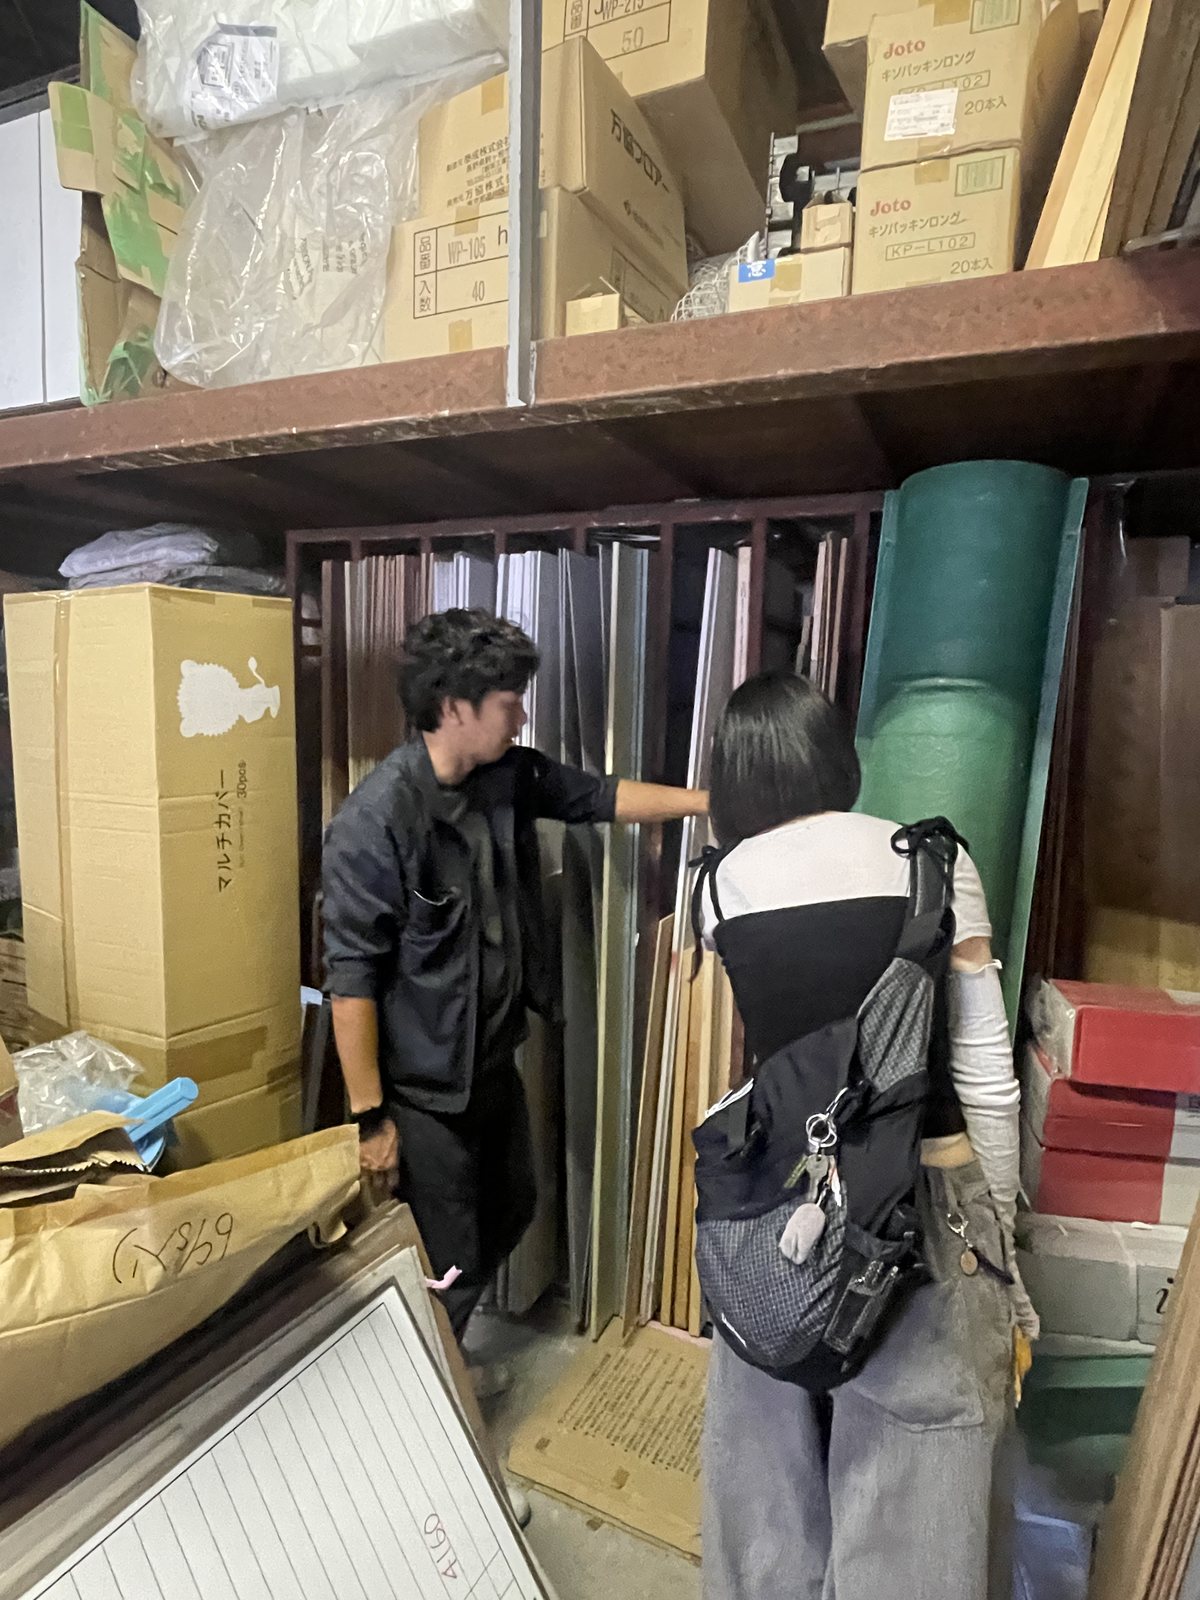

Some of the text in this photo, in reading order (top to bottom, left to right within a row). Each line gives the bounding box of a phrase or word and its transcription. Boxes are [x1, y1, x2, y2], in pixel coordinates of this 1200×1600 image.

[621, 26, 645, 53] 50
[883, 40, 926, 60] Joto
[963, 95, 1008, 116] 20本入
[870, 199, 912, 217] Joto
[419, 235, 431, 270] 品番
[447, 235, 486, 265] WP-105
[891, 236, 969, 258] KP-L102
[950, 257, 994, 275] 20本入
[419, 280, 431, 313] 入数
[472, 280, 485, 302] 40
[214, 769, 232, 893] マルチカバー
